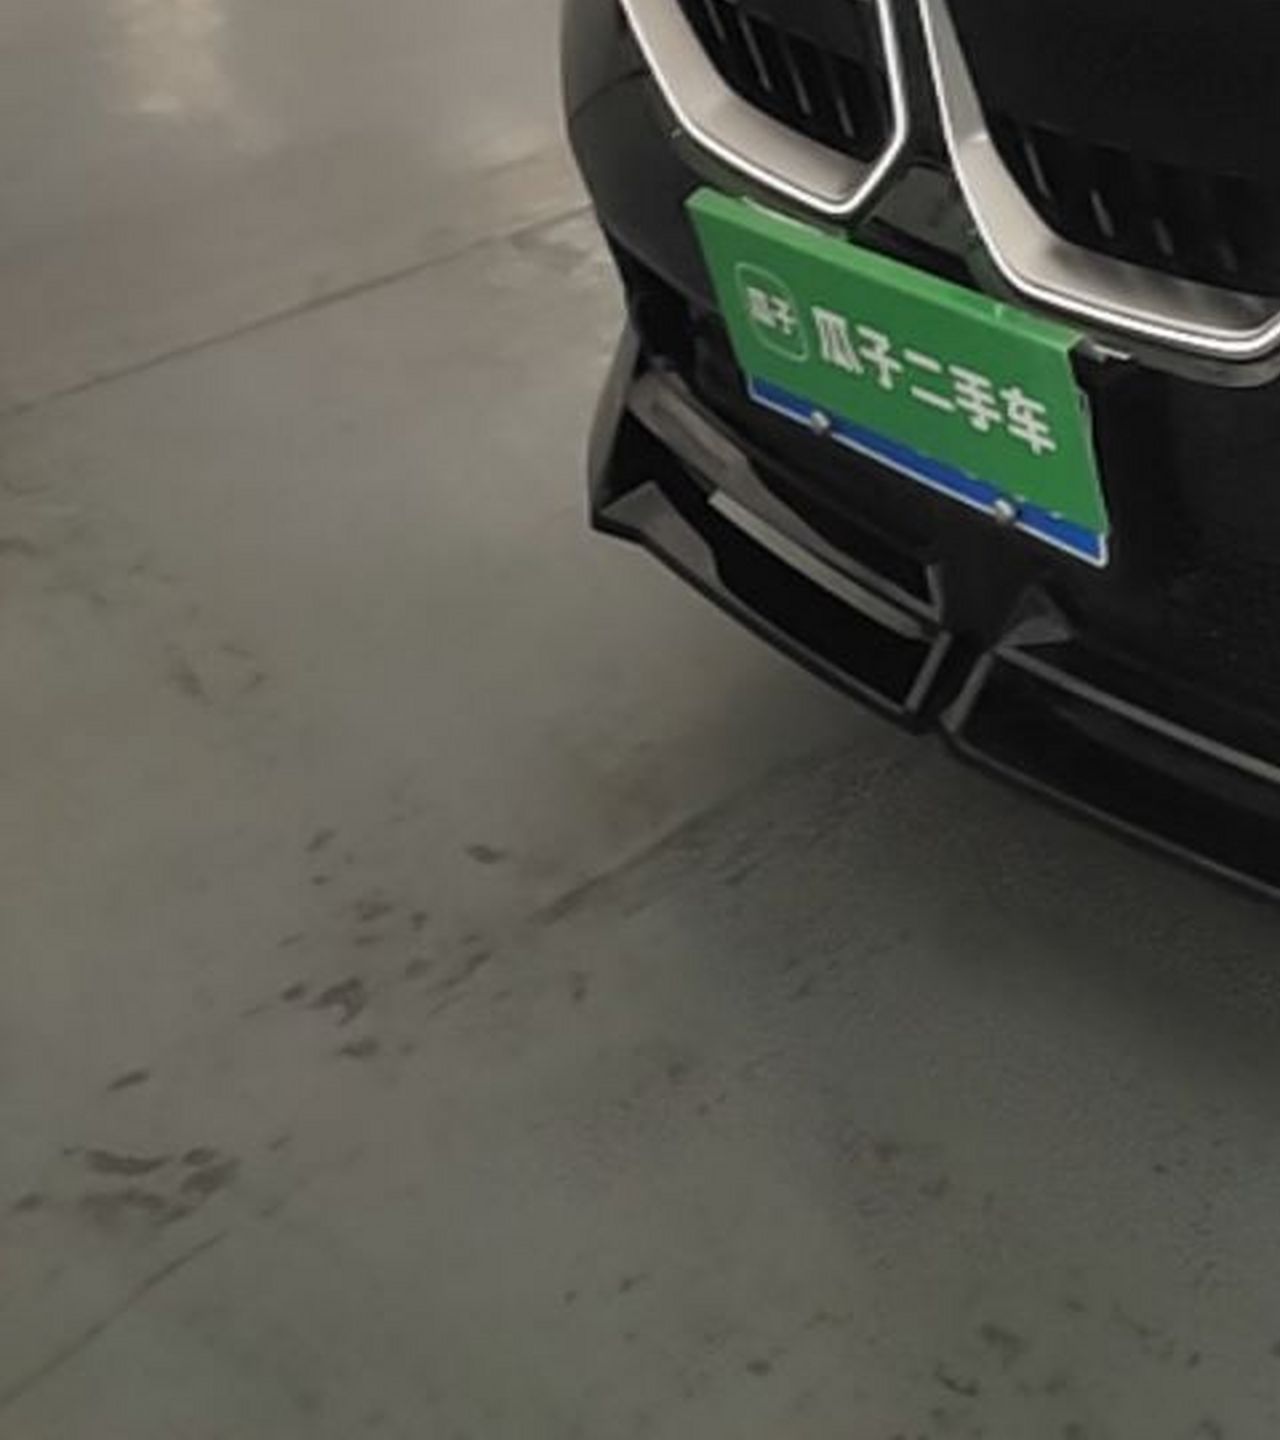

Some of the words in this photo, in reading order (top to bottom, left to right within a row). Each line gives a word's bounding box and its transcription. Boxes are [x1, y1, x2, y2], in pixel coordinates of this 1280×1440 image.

[811, 305, 1058, 457] 瓜子二手车
